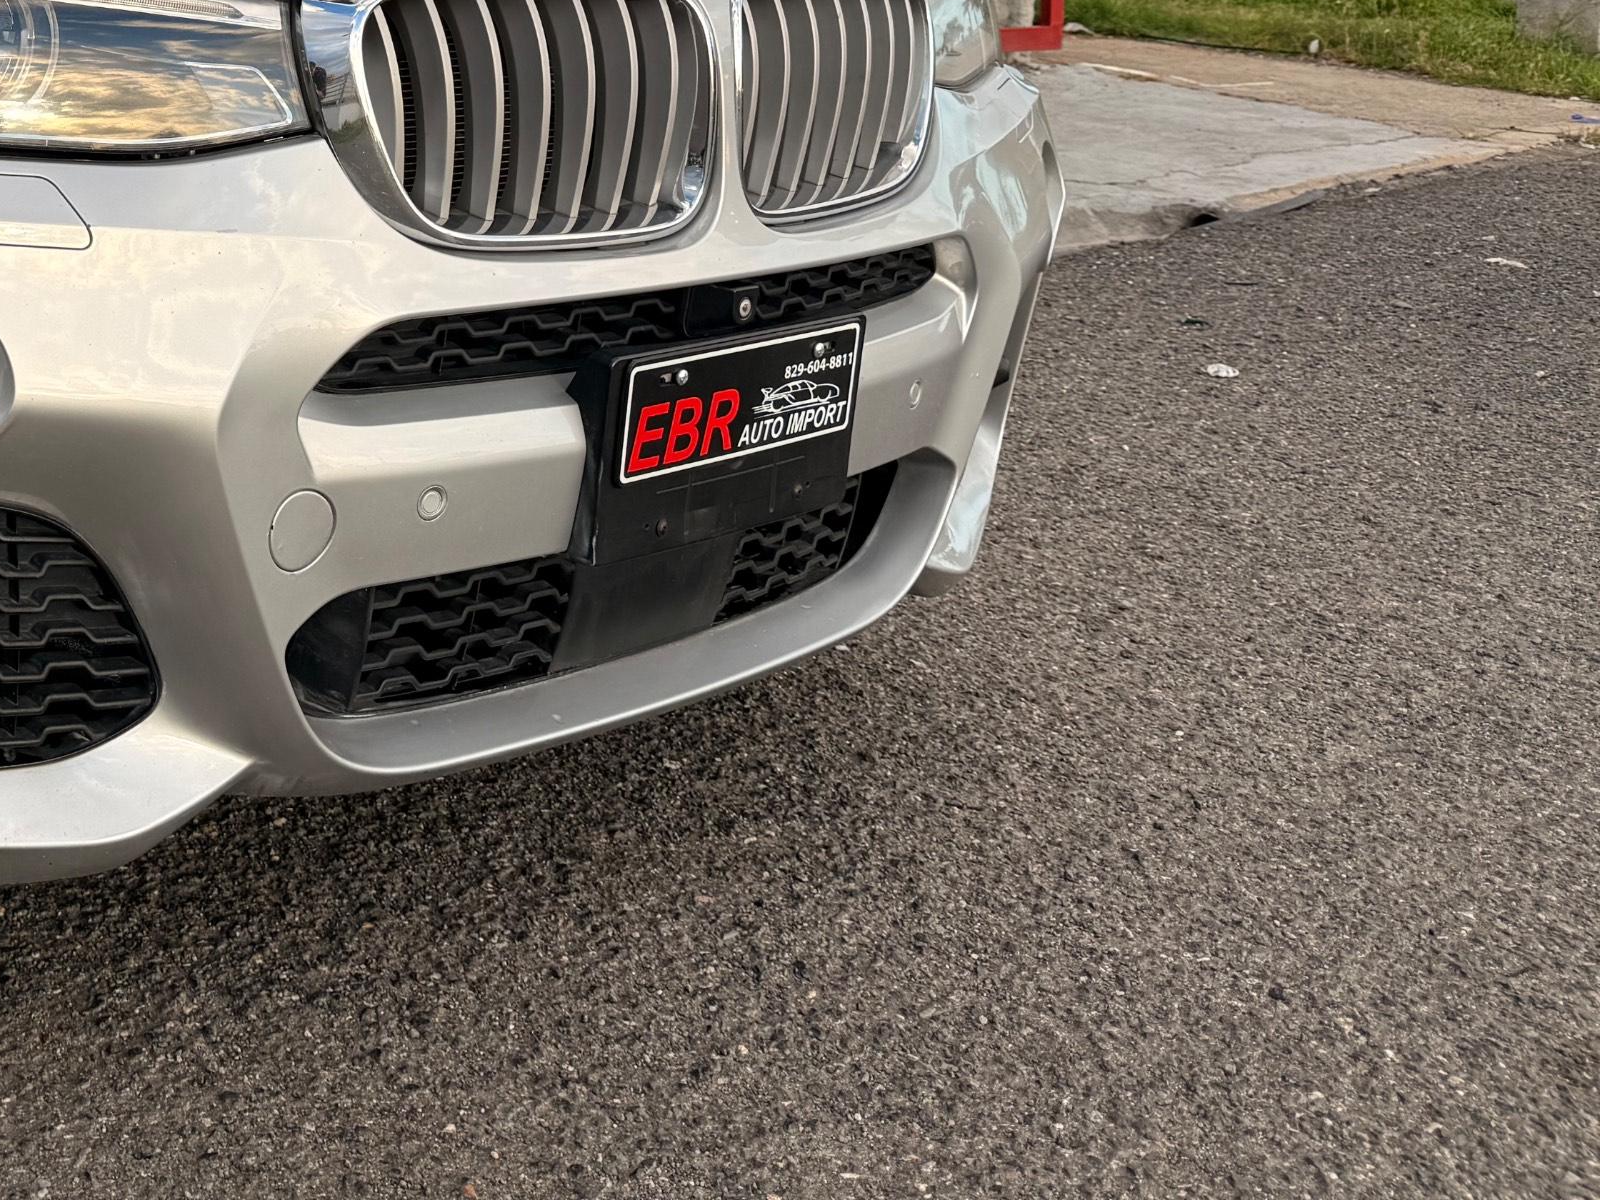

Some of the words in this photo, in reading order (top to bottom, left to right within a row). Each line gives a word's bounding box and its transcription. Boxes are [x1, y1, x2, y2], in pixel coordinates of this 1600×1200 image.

[784, 352, 853, 379] 829-604-8811
[627, 388, 741, 473] EBR
[737, 416, 785, 448] AUTO
[785, 400, 847, 436] IMPORT
